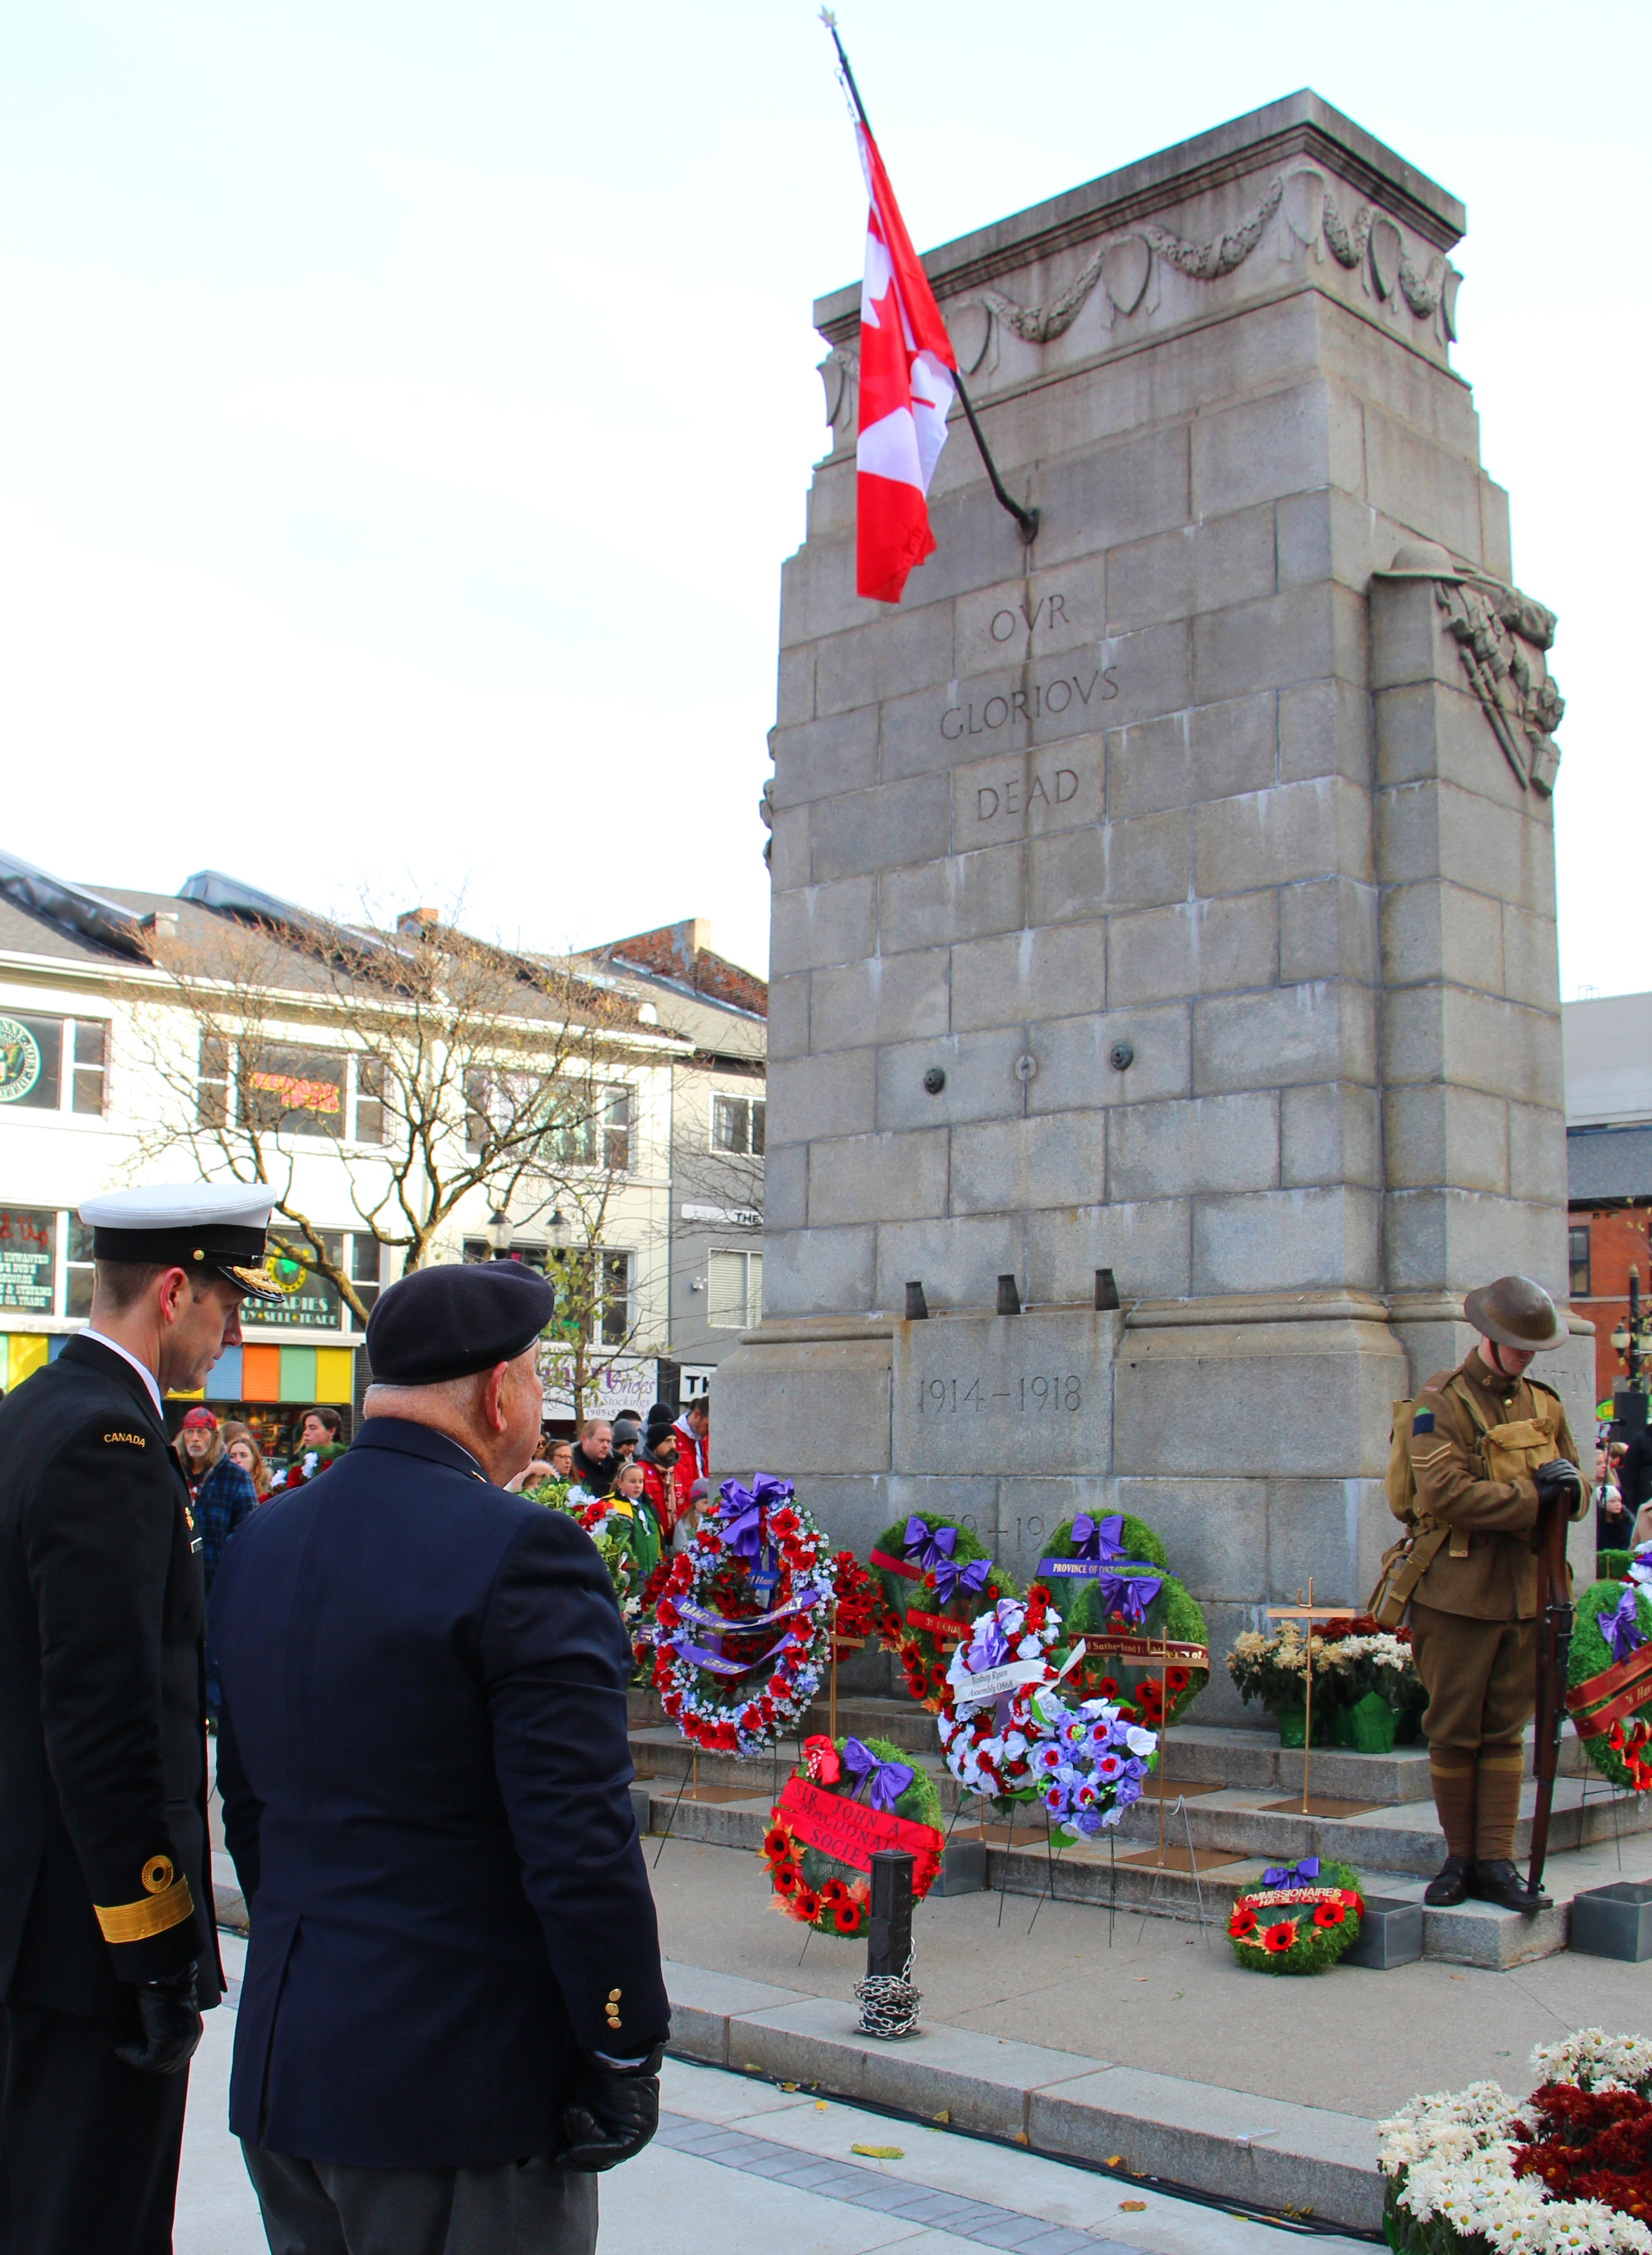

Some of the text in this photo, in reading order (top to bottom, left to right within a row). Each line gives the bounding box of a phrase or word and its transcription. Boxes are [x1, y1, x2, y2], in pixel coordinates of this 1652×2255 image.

[940, 665, 1119, 740] GLORIOVS
[977, 769, 1079, 821] DEAD
[735, 1212, 760, 1223] THE
[4, 1252, 50, 1265] UNWANTED
[15, 1285, 53, 1297] SYSTEMS
[18, 1295, 46, 1308] TRADE
[299, 1313, 337, 1325] TRADE
[603, 1395, 650, 1410] Stockings
[104, 1433, 146, 1448] CANADA
[1052, 1563, 1087, 1574] PROVINCE
[1089, 1565, 1098, 1574] OF
[926, 1617, 933, 1627] 31
[972, 1670, 1008, 1684] Bishop Ryan
[968, 1680, 1013, 1697] Assembly 0868
[794, 1783, 899, 1837] SIR JOHN A
[810, 1829, 872, 1867] SOCIET
[1239, 1887, 1342, 1904] COMMISSIONAIRES
